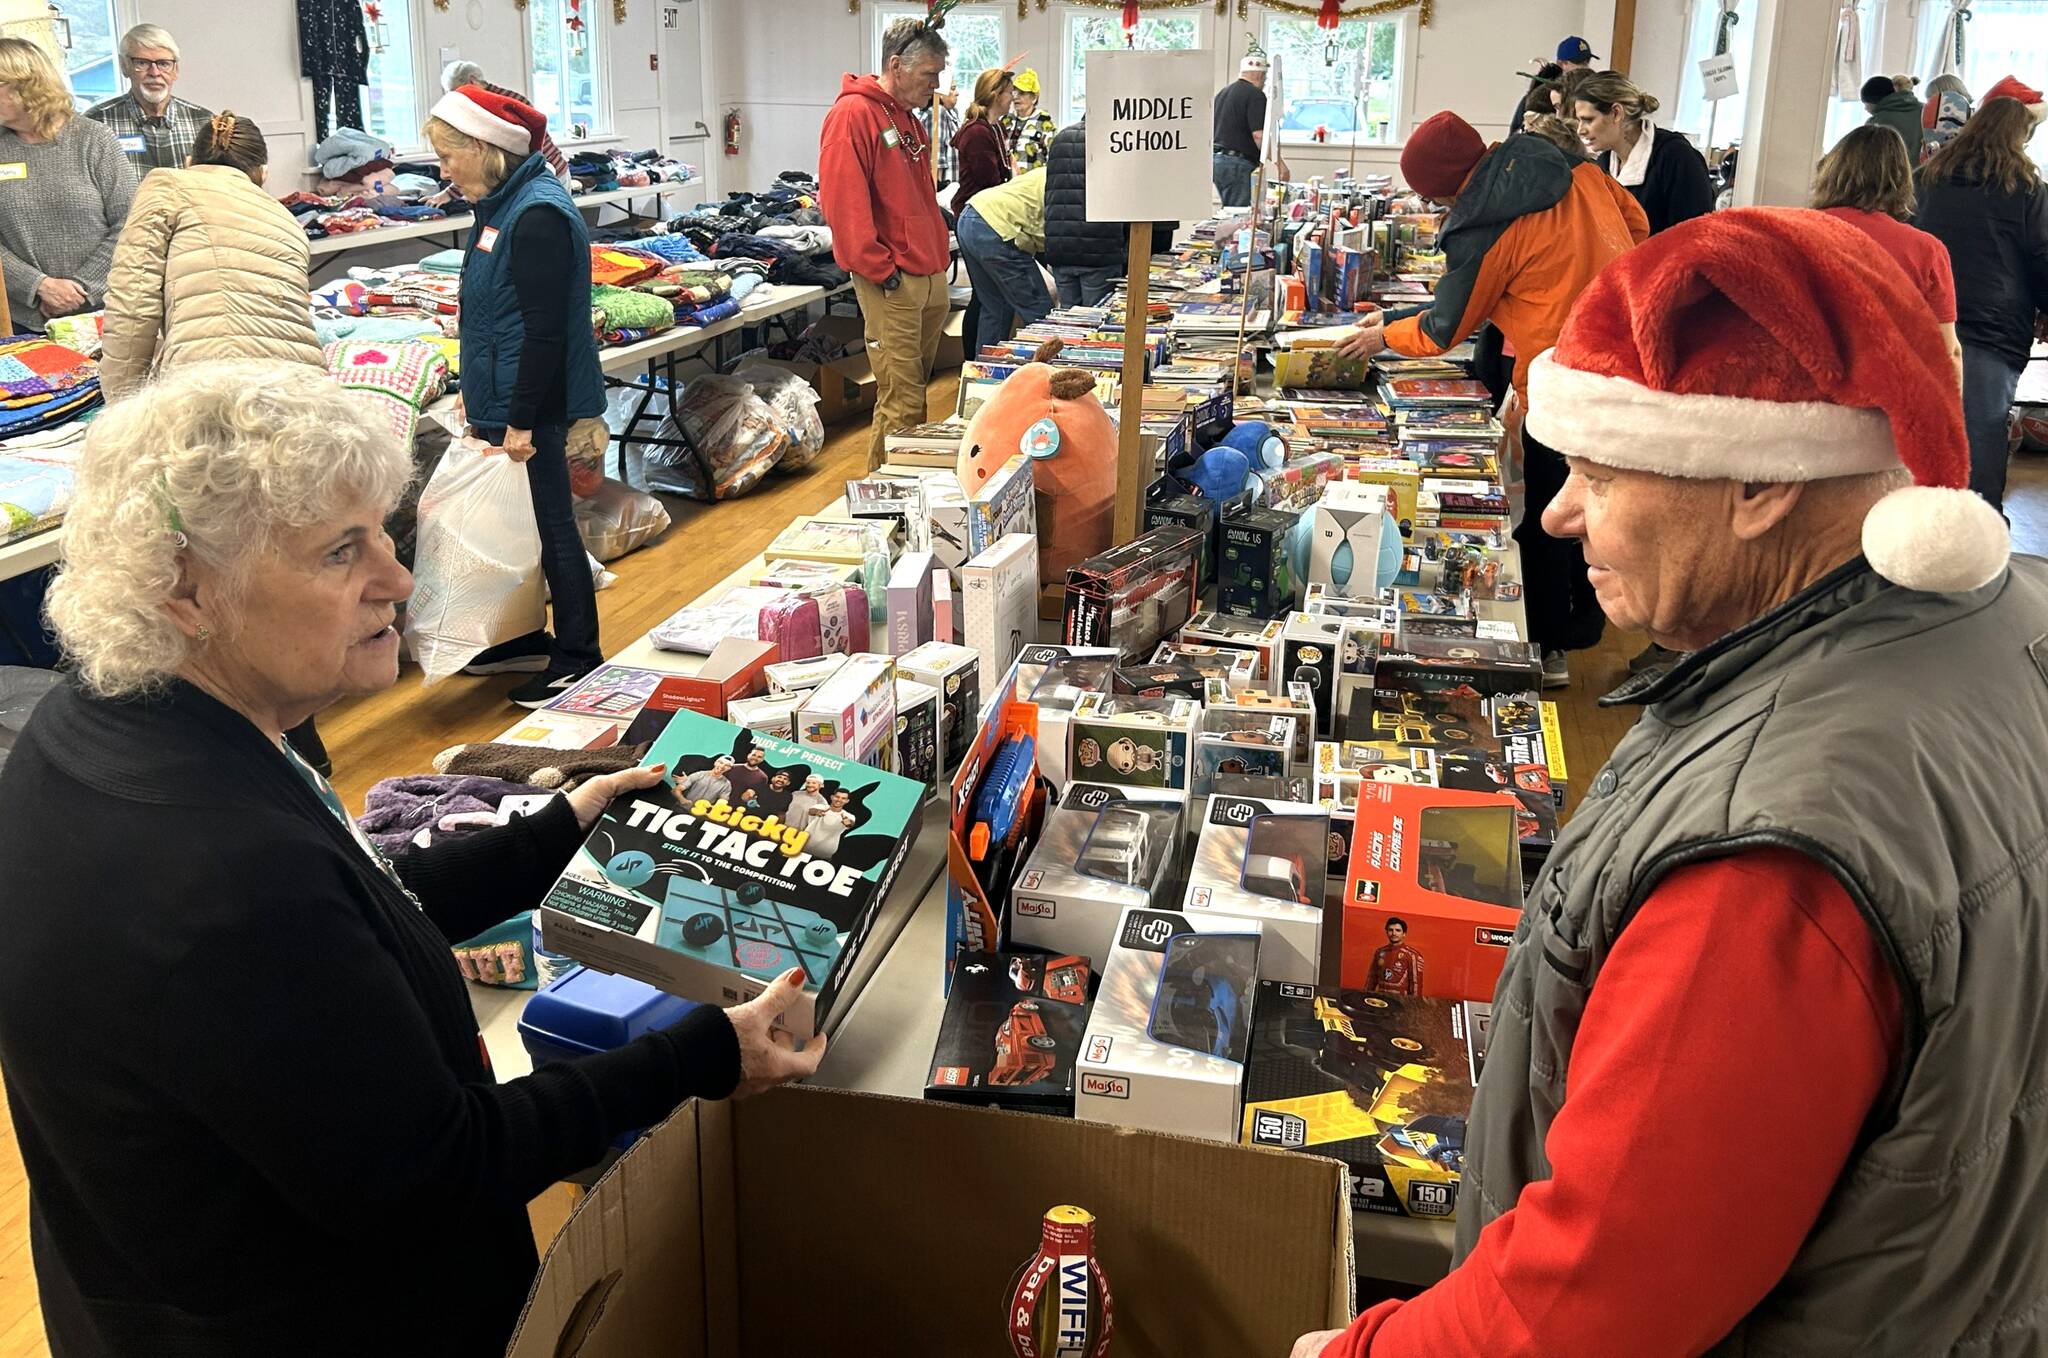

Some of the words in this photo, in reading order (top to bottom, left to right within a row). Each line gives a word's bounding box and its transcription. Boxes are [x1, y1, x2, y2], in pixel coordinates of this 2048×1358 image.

[664, 8, 678, 28] EXIT
[1113, 97, 1193, 121] MIDDLE
[1110, 130, 1188, 154] SCHOOL
[1227, 529, 1251, 542] AMONG
[1252, 533, 1262, 544] US
[750, 736, 779, 751] DUDE
[801, 751, 845, 771] PERFECT
[690, 798, 809, 856] sticky
[1393, 815, 1403, 831] DE
[626, 799, 697, 841] TIC
[695, 821, 779, 868] TAC
[781, 852, 863, 898] TOE
[1390, 831, 1402, 872] COURSE
[661, 842, 691, 857] STICK
[691, 850, 701, 859] IT
[701, 853, 713, 864] TO
[713, 858, 733, 870] THE
[732, 864, 797, 892] COMPETITION!
[553, 889, 582, 903] CHOKING
[583, 897, 608, 911] HAZARD
[613, 907, 627, 919] This
[627, 912, 638, 922] toy
[578, 886, 627, 908] WARNING
[1021, 902, 1051, 915] Maisto
[546, 899, 558, 908] Not
[559, 901, 568, 910] for
[568, 904, 593, 920] children
[593, 913, 610, 925] under
[581, 904, 598, 915] small
[834, 936, 858, 991] DUDE
[876, 830, 911, 908] PERFECT
[1087, 1079, 1123, 1094] Maisto
[1259, 1117, 1283, 1139] 150
[1285, 1121, 1293, 1140] PIECES
[1417, 1187, 1447, 1203] 150
[1021, 1256, 1056, 1302] bat
[1017, 1307, 1029, 1328] &
